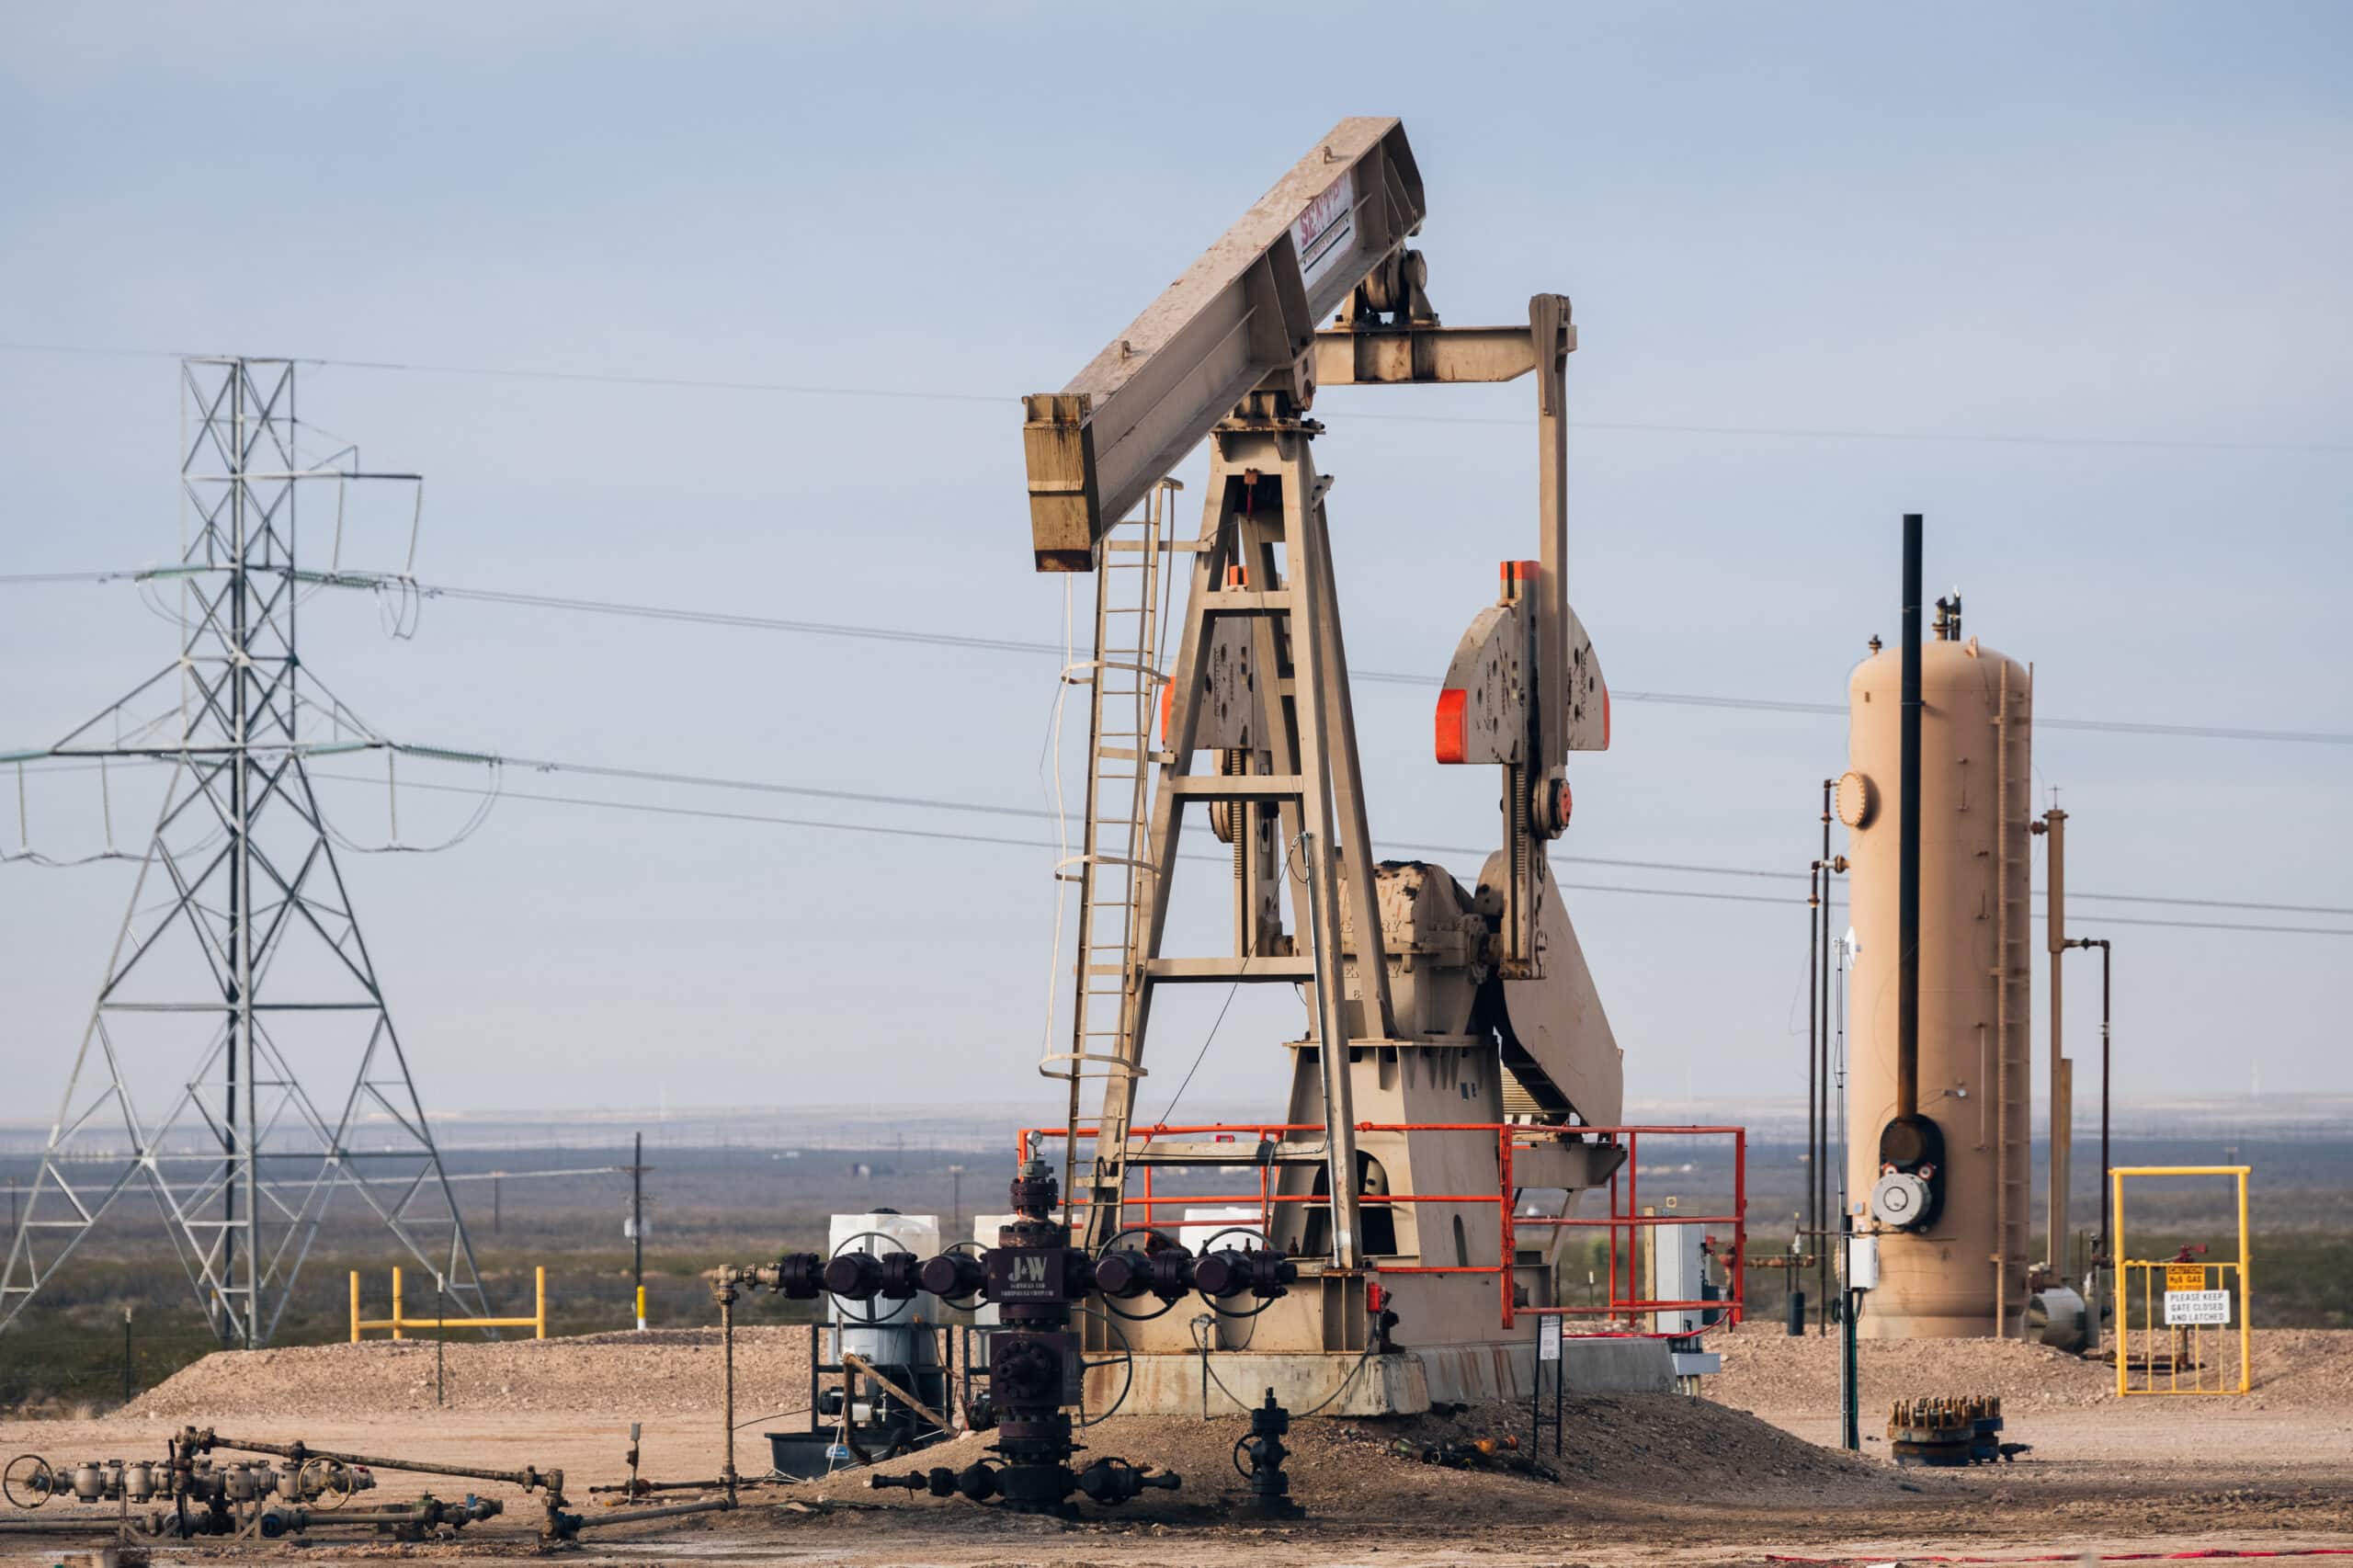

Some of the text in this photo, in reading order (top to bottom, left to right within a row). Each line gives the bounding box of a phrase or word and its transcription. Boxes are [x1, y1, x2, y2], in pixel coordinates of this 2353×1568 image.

[1007, 1256, 1048, 1281] J&W
[2187, 1275, 2202, 1283] GAS
[2170, 1292, 2223, 1301] PLEASE KEEP
[2171, 1302, 2223, 1312] GATE CLOSED
[2172, 1312, 2224, 1322] AND LATCHED
